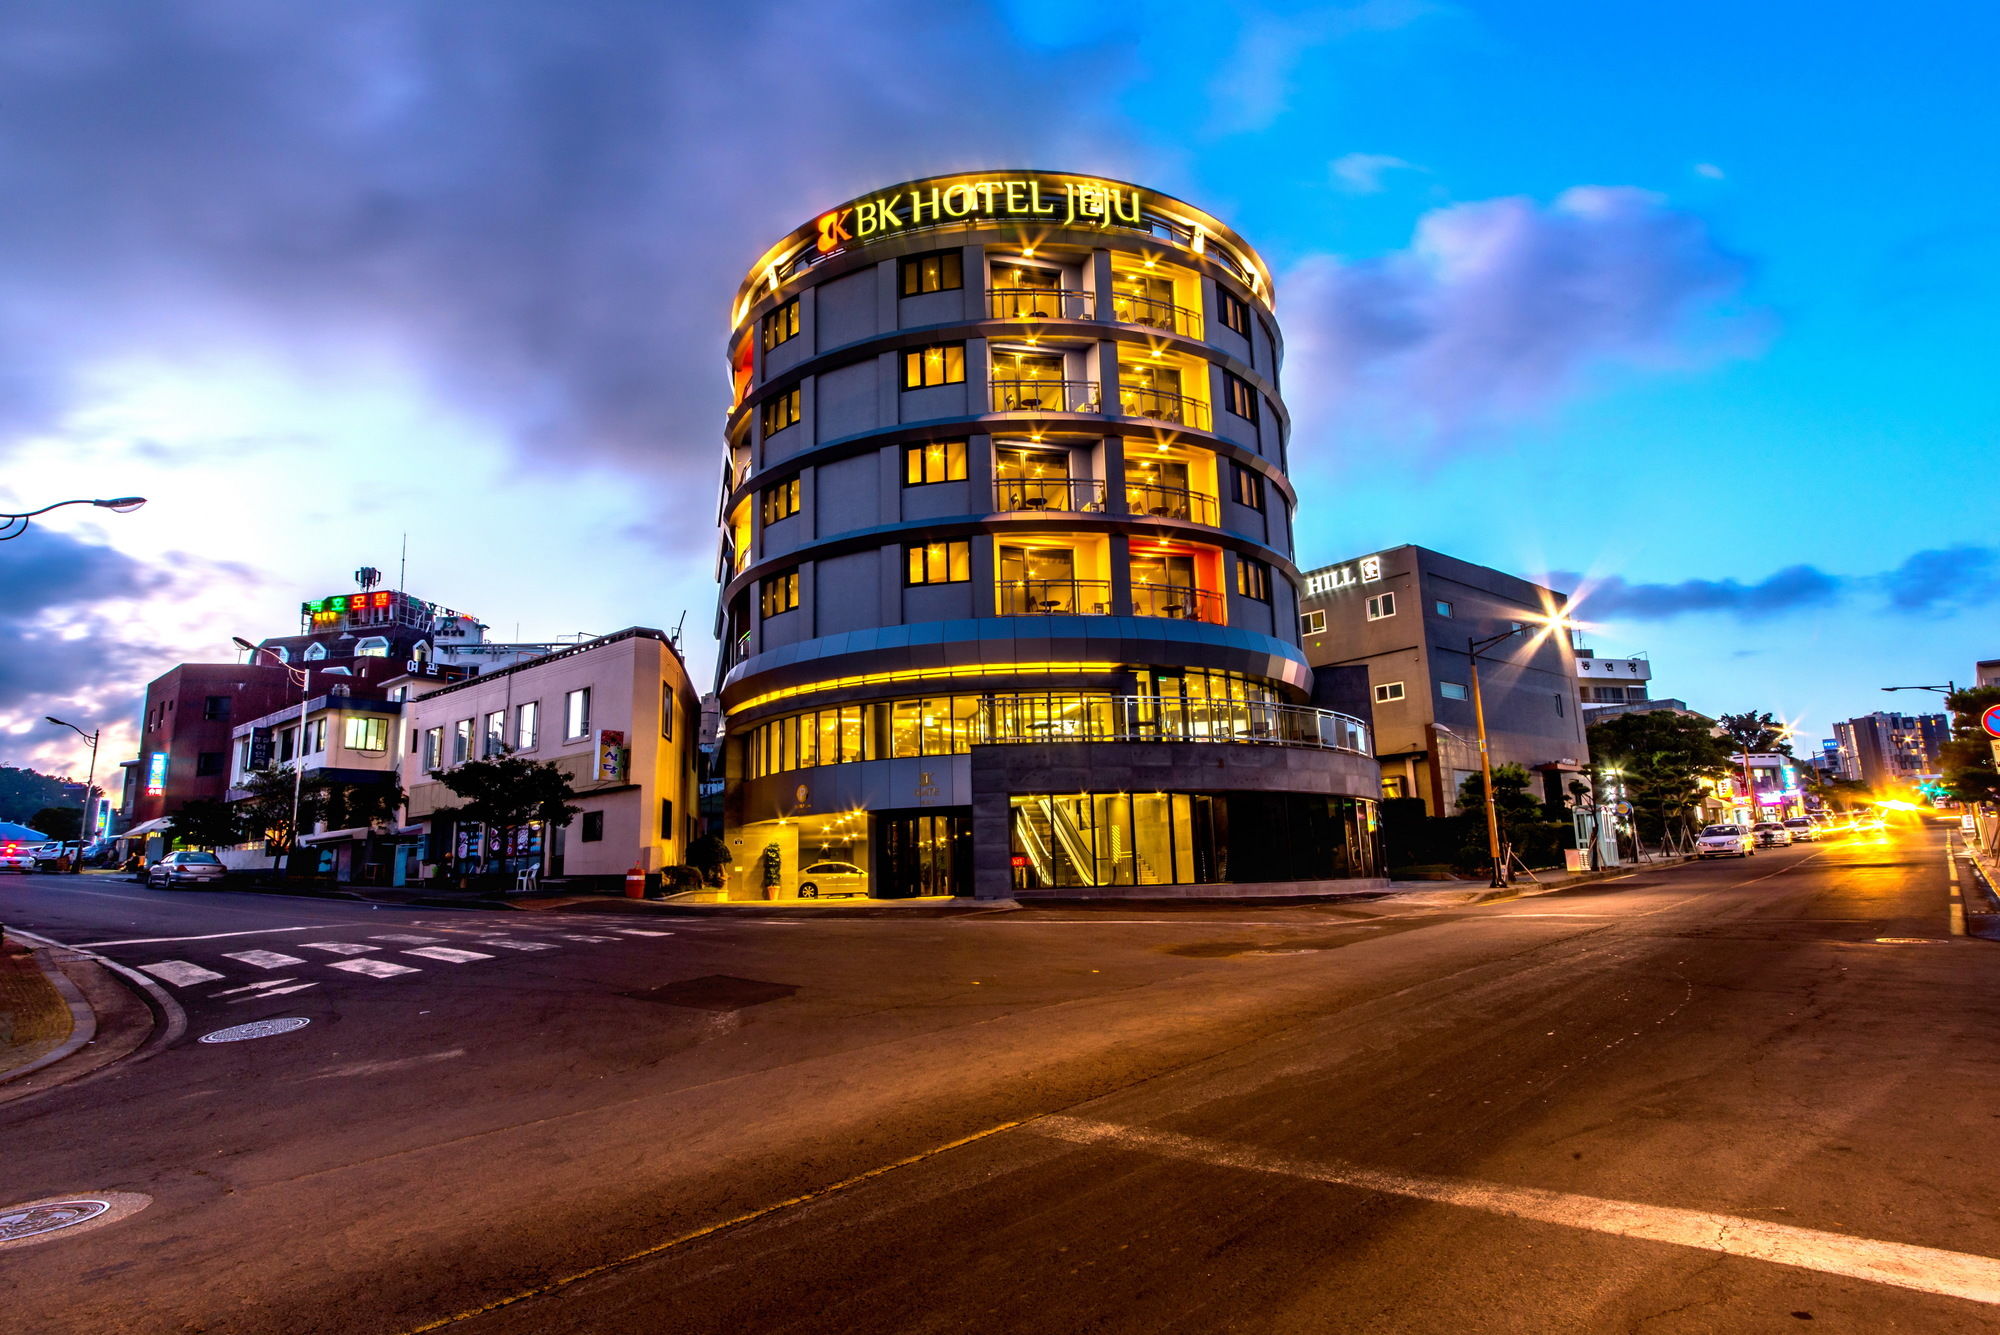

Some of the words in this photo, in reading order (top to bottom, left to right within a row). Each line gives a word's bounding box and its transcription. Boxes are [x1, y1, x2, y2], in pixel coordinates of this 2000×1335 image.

[856, 193, 903, 237] BK
[909, 180, 1054, 223] HOTEL
[1063, 181, 1140, 229] JEJU
[1306, 567, 1356, 595] HILL
